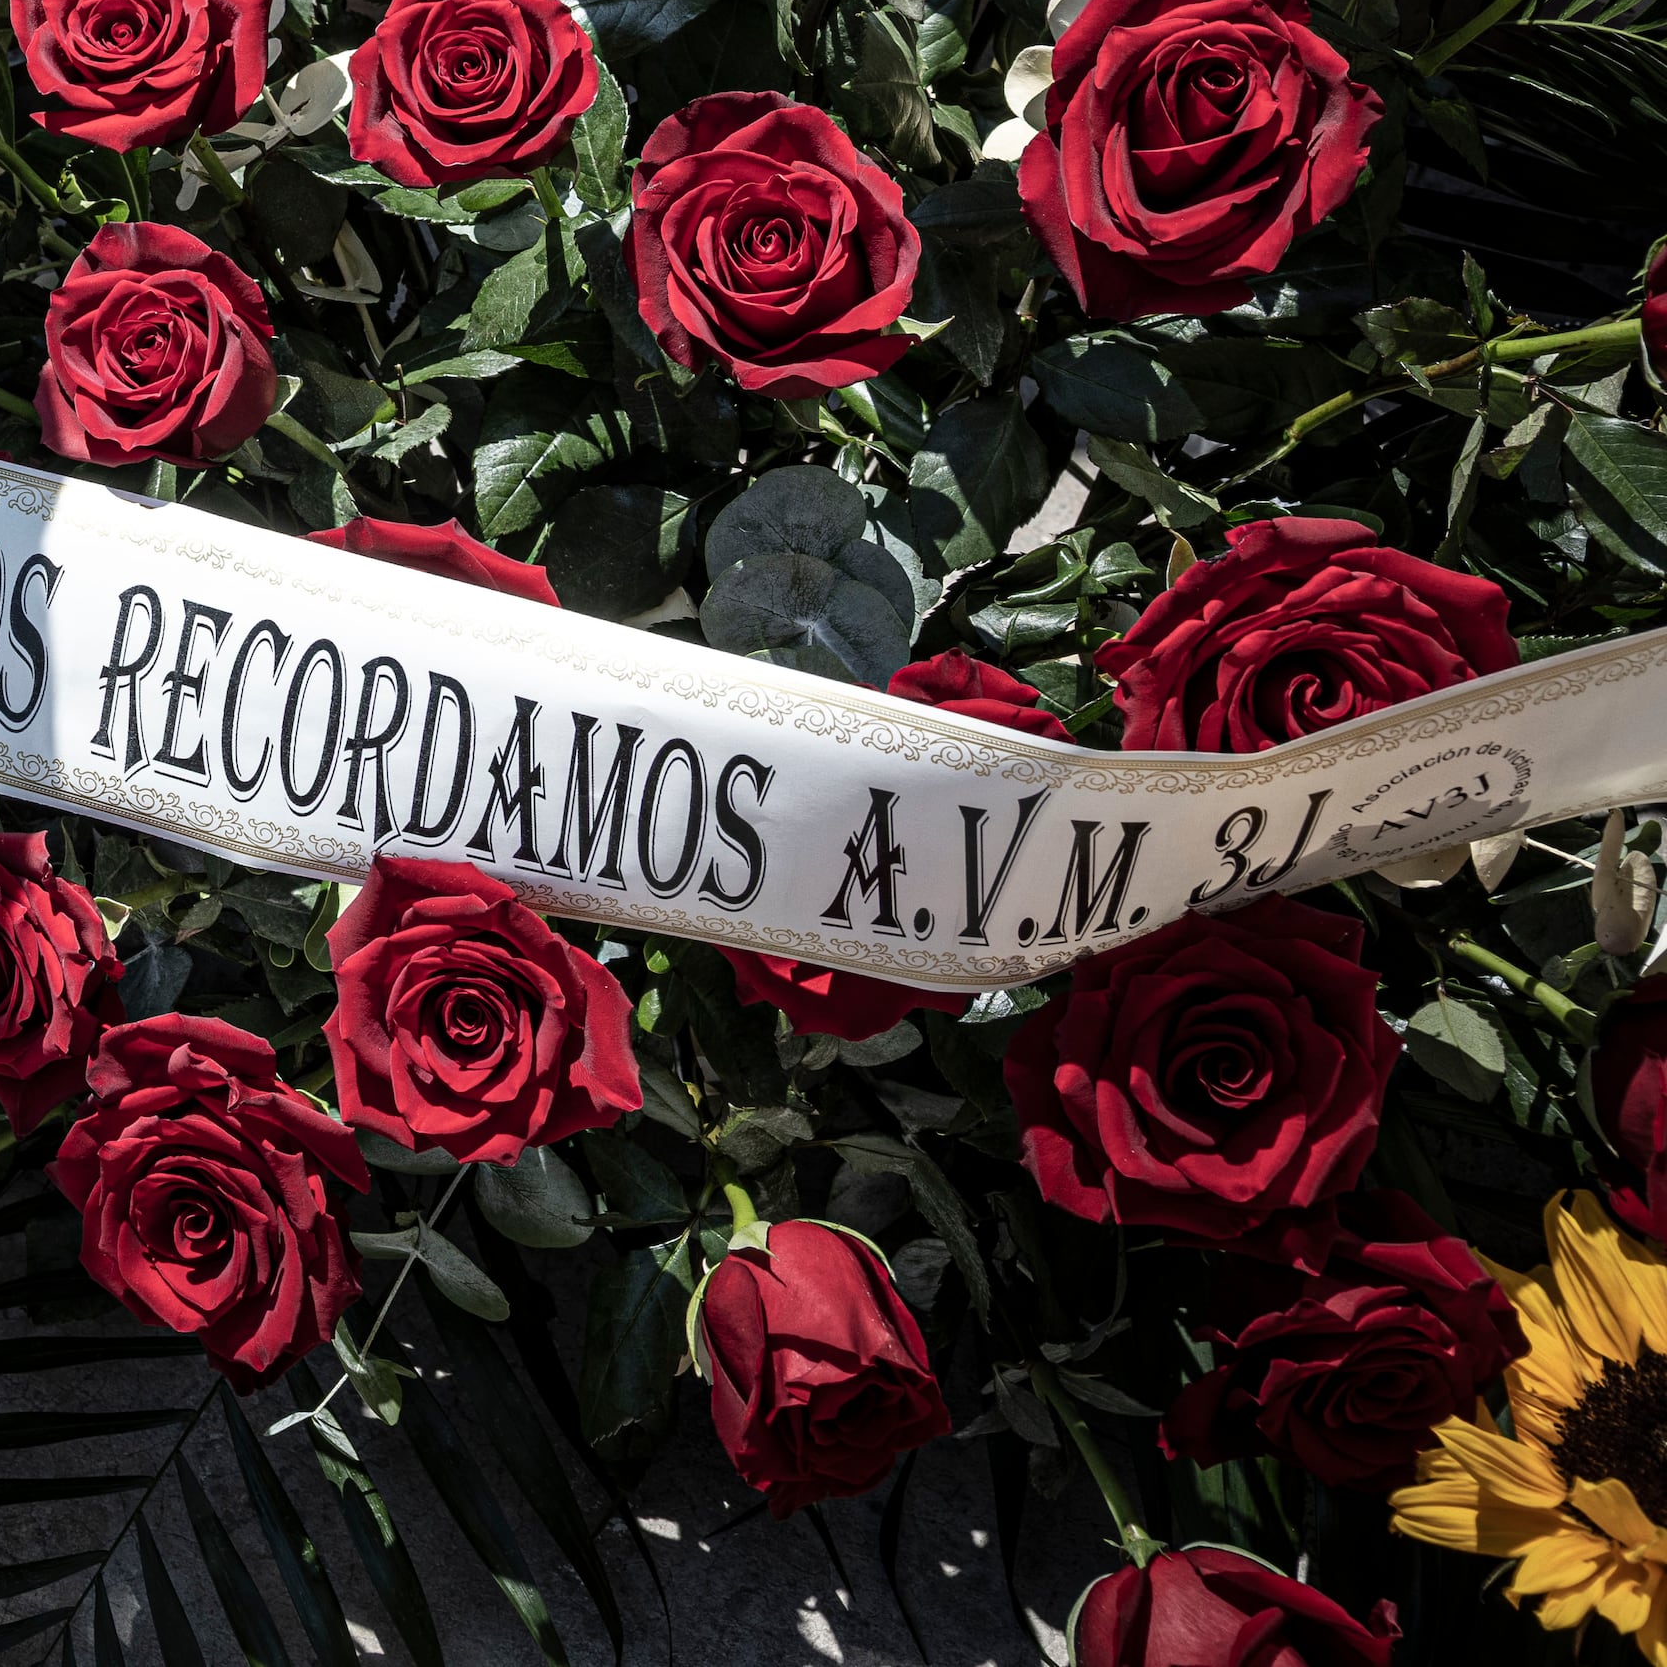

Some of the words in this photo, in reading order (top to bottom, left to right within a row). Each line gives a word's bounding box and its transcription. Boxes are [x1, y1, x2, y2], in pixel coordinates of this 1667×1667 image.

[90, 584, 775, 912] RECORDAMOS
[820, 787, 1151, 949] A.V.M.
[1184, 788, 1335, 908] 3J
[1475, 741, 1502, 756] de
[1502, 748, 1535, 798] víctimas
[1351, 745, 1471, 814] Asociación
[1370, 771, 1492, 842] AV3J
[1482, 798, 1514, 819] del
[1328, 822, 1354, 851] Julio
